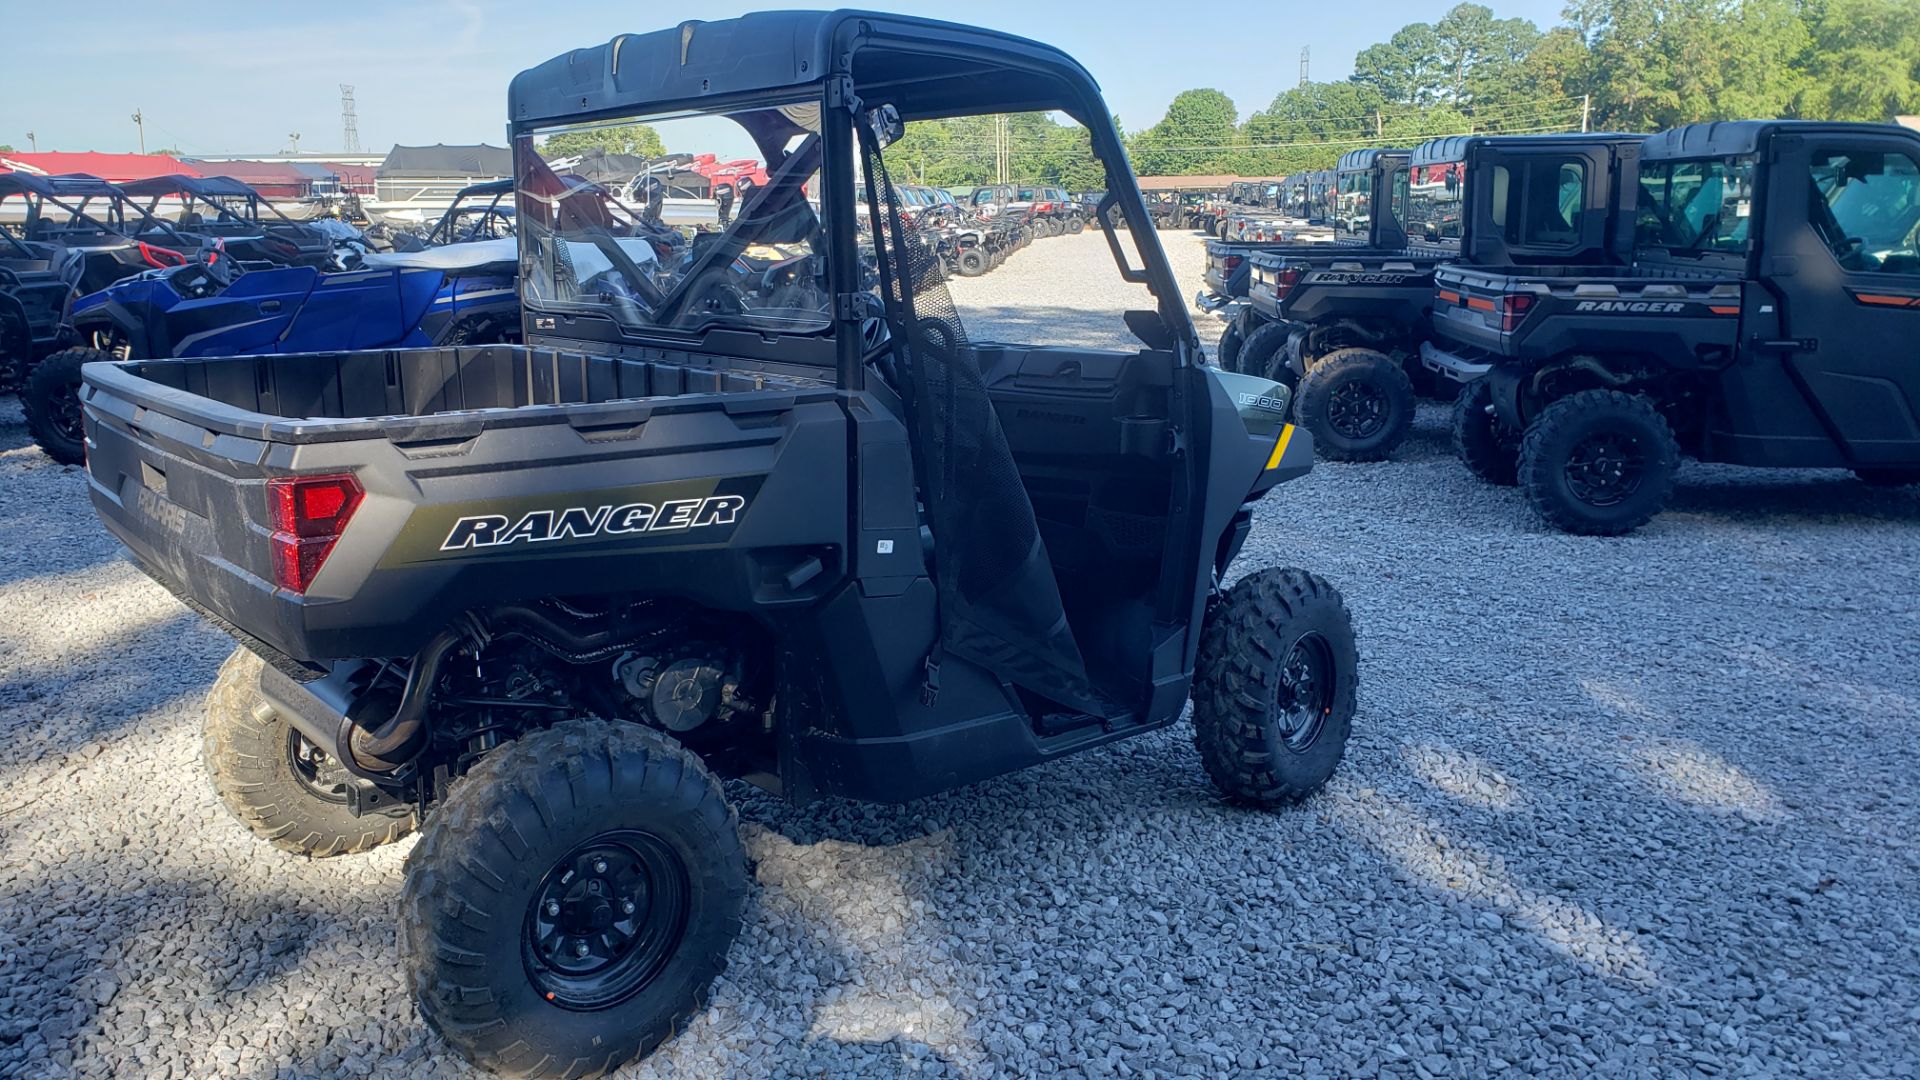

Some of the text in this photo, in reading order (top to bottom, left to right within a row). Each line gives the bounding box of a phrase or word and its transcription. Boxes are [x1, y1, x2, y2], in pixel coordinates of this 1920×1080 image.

[1315, 273, 1406, 284] RANGER
[1575, 301, 1685, 313] RANGER
[1239, 392, 1283, 410] 1000
[138, 489, 186, 535] POLARIS
[440, 495, 745, 551] RANGER
